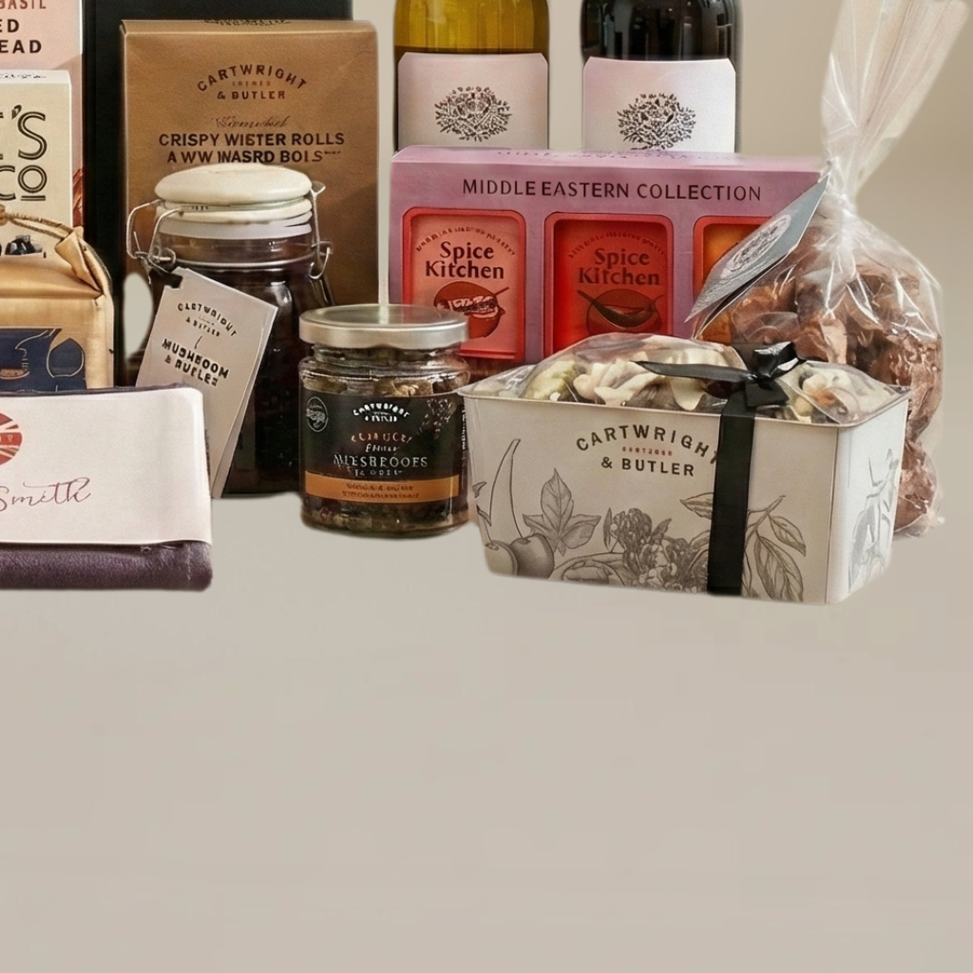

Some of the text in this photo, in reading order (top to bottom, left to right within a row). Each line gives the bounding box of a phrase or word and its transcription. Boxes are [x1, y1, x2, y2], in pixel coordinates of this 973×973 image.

[158, 132, 221, 147] CRISPY
[290, 132, 345, 146] ROLLS
[462, 178, 762, 202] MIDDLE EASTERN COLLECTION
[439, 240, 495, 265] Spice
[594, 247, 650, 270] Spice
[424, 259, 505, 280] Kitchen
[578, 267, 661, 286] Kitchen
[601, 456, 695, 477] & BUTLER
